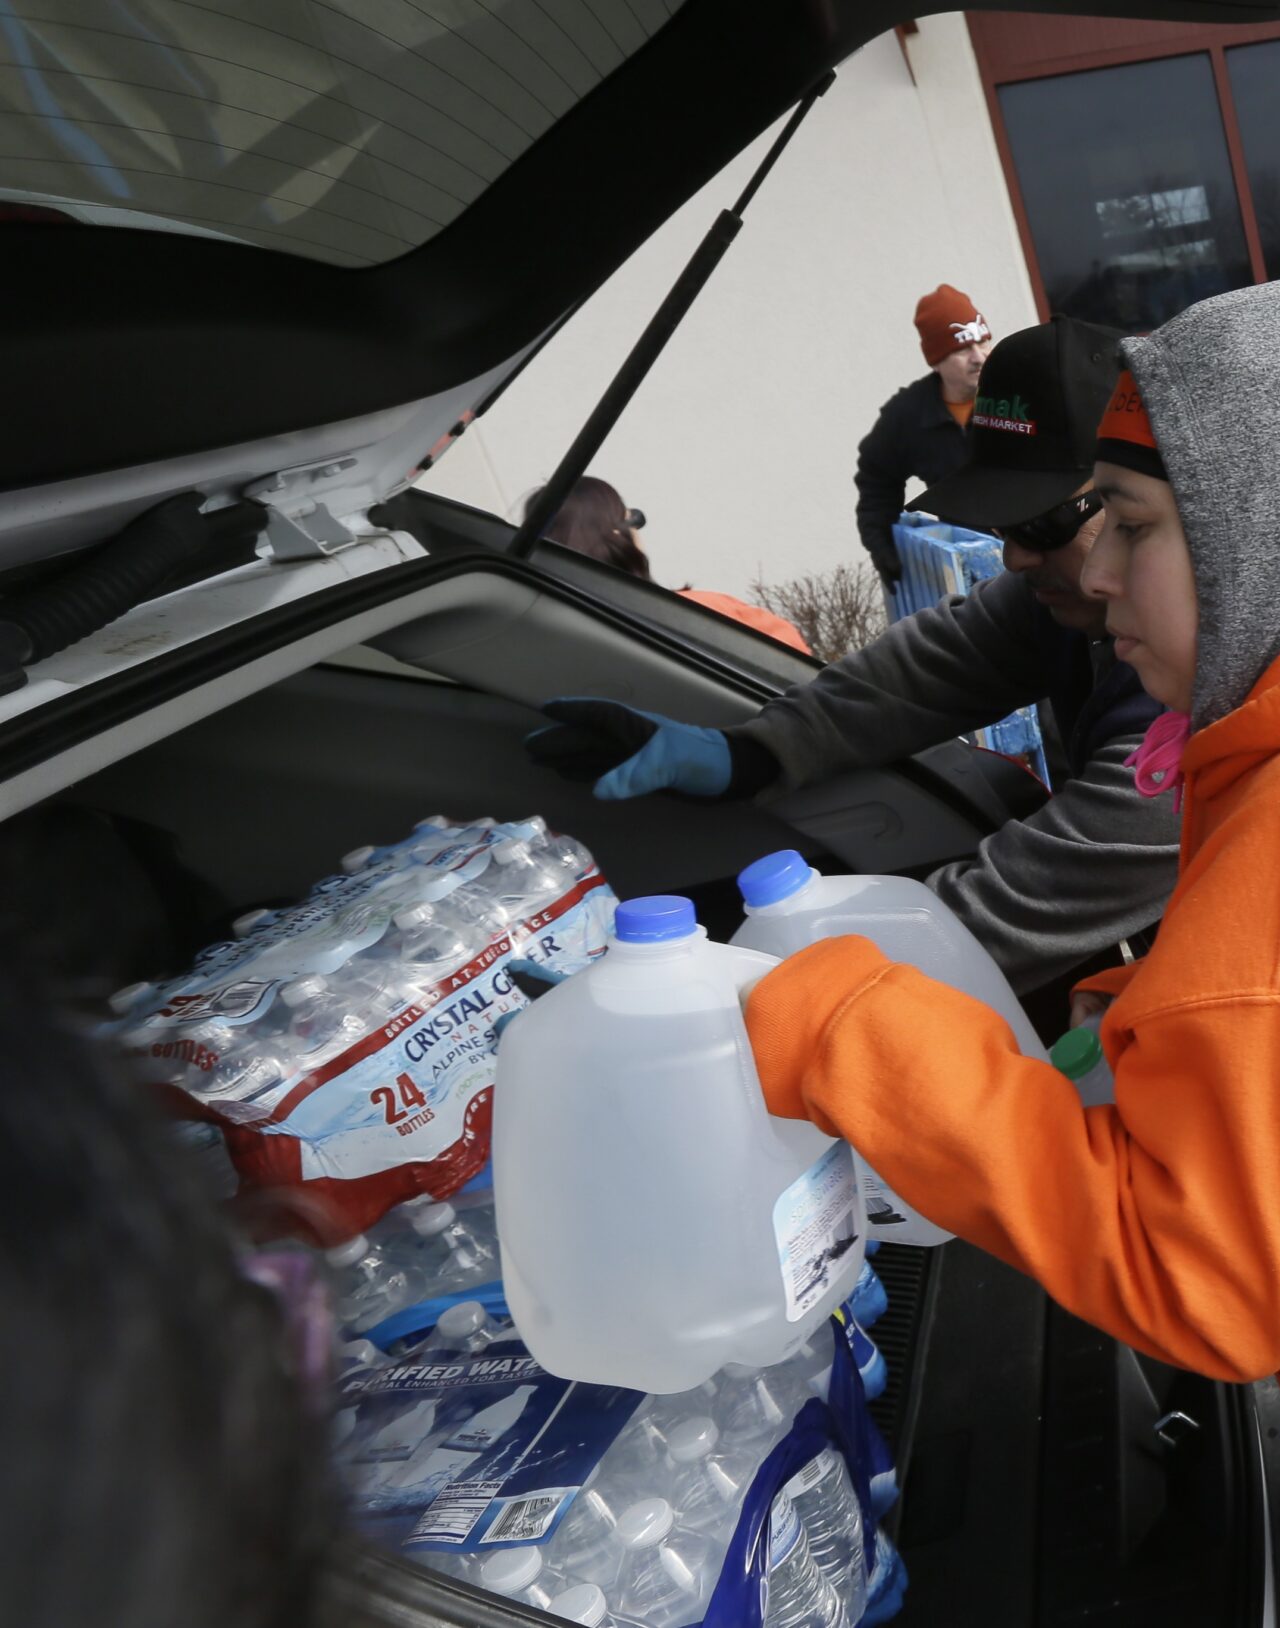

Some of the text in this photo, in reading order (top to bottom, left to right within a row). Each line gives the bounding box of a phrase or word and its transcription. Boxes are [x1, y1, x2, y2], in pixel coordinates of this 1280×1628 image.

[989, 418, 1033, 434] MARKET
[384, 991, 441, 1039] BOTTLED
[451, 969, 474, 988] AT
[404, 989, 494, 1063] CRYSTAL
[151, 1039, 219, 1072] BOTTLES
[432, 1036, 484, 1080] ALPINE
[468, 1051, 487, 1065] BY
[370, 1072, 428, 1125] 24
[396, 1108, 436, 1137] BOTTLES
[403, 1377, 470, 1389] ENHANCED
[471, 1374, 497, 1384] FOR
[445, 1481, 501, 1491] Nutrition Facts
